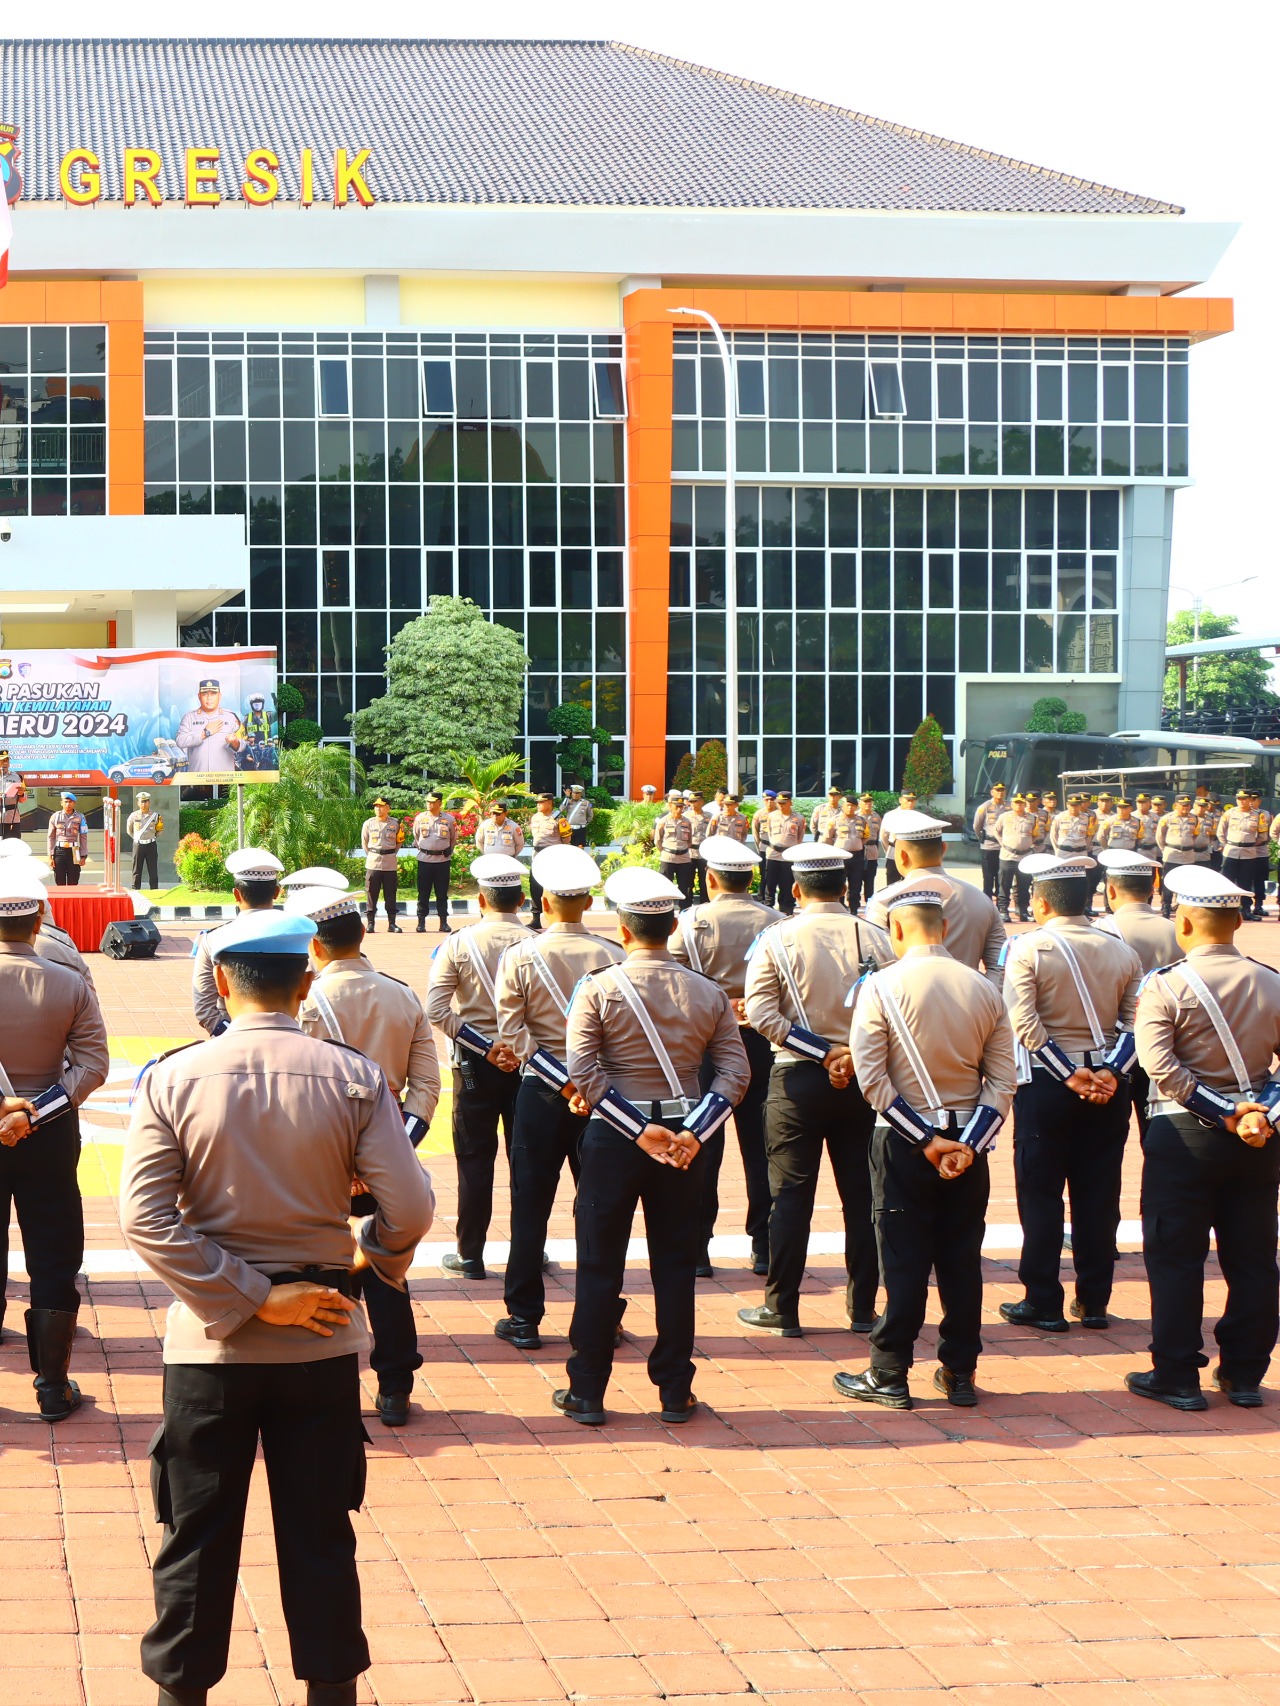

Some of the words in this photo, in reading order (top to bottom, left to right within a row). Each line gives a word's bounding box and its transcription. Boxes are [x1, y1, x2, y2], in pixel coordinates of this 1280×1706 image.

[59, 147, 376, 207] GRESIK
[6, 682, 100, 701] PASUKAN
[14, 700, 112, 714] KEWILAYAHAN
[62, 712, 129, 739] 2024
